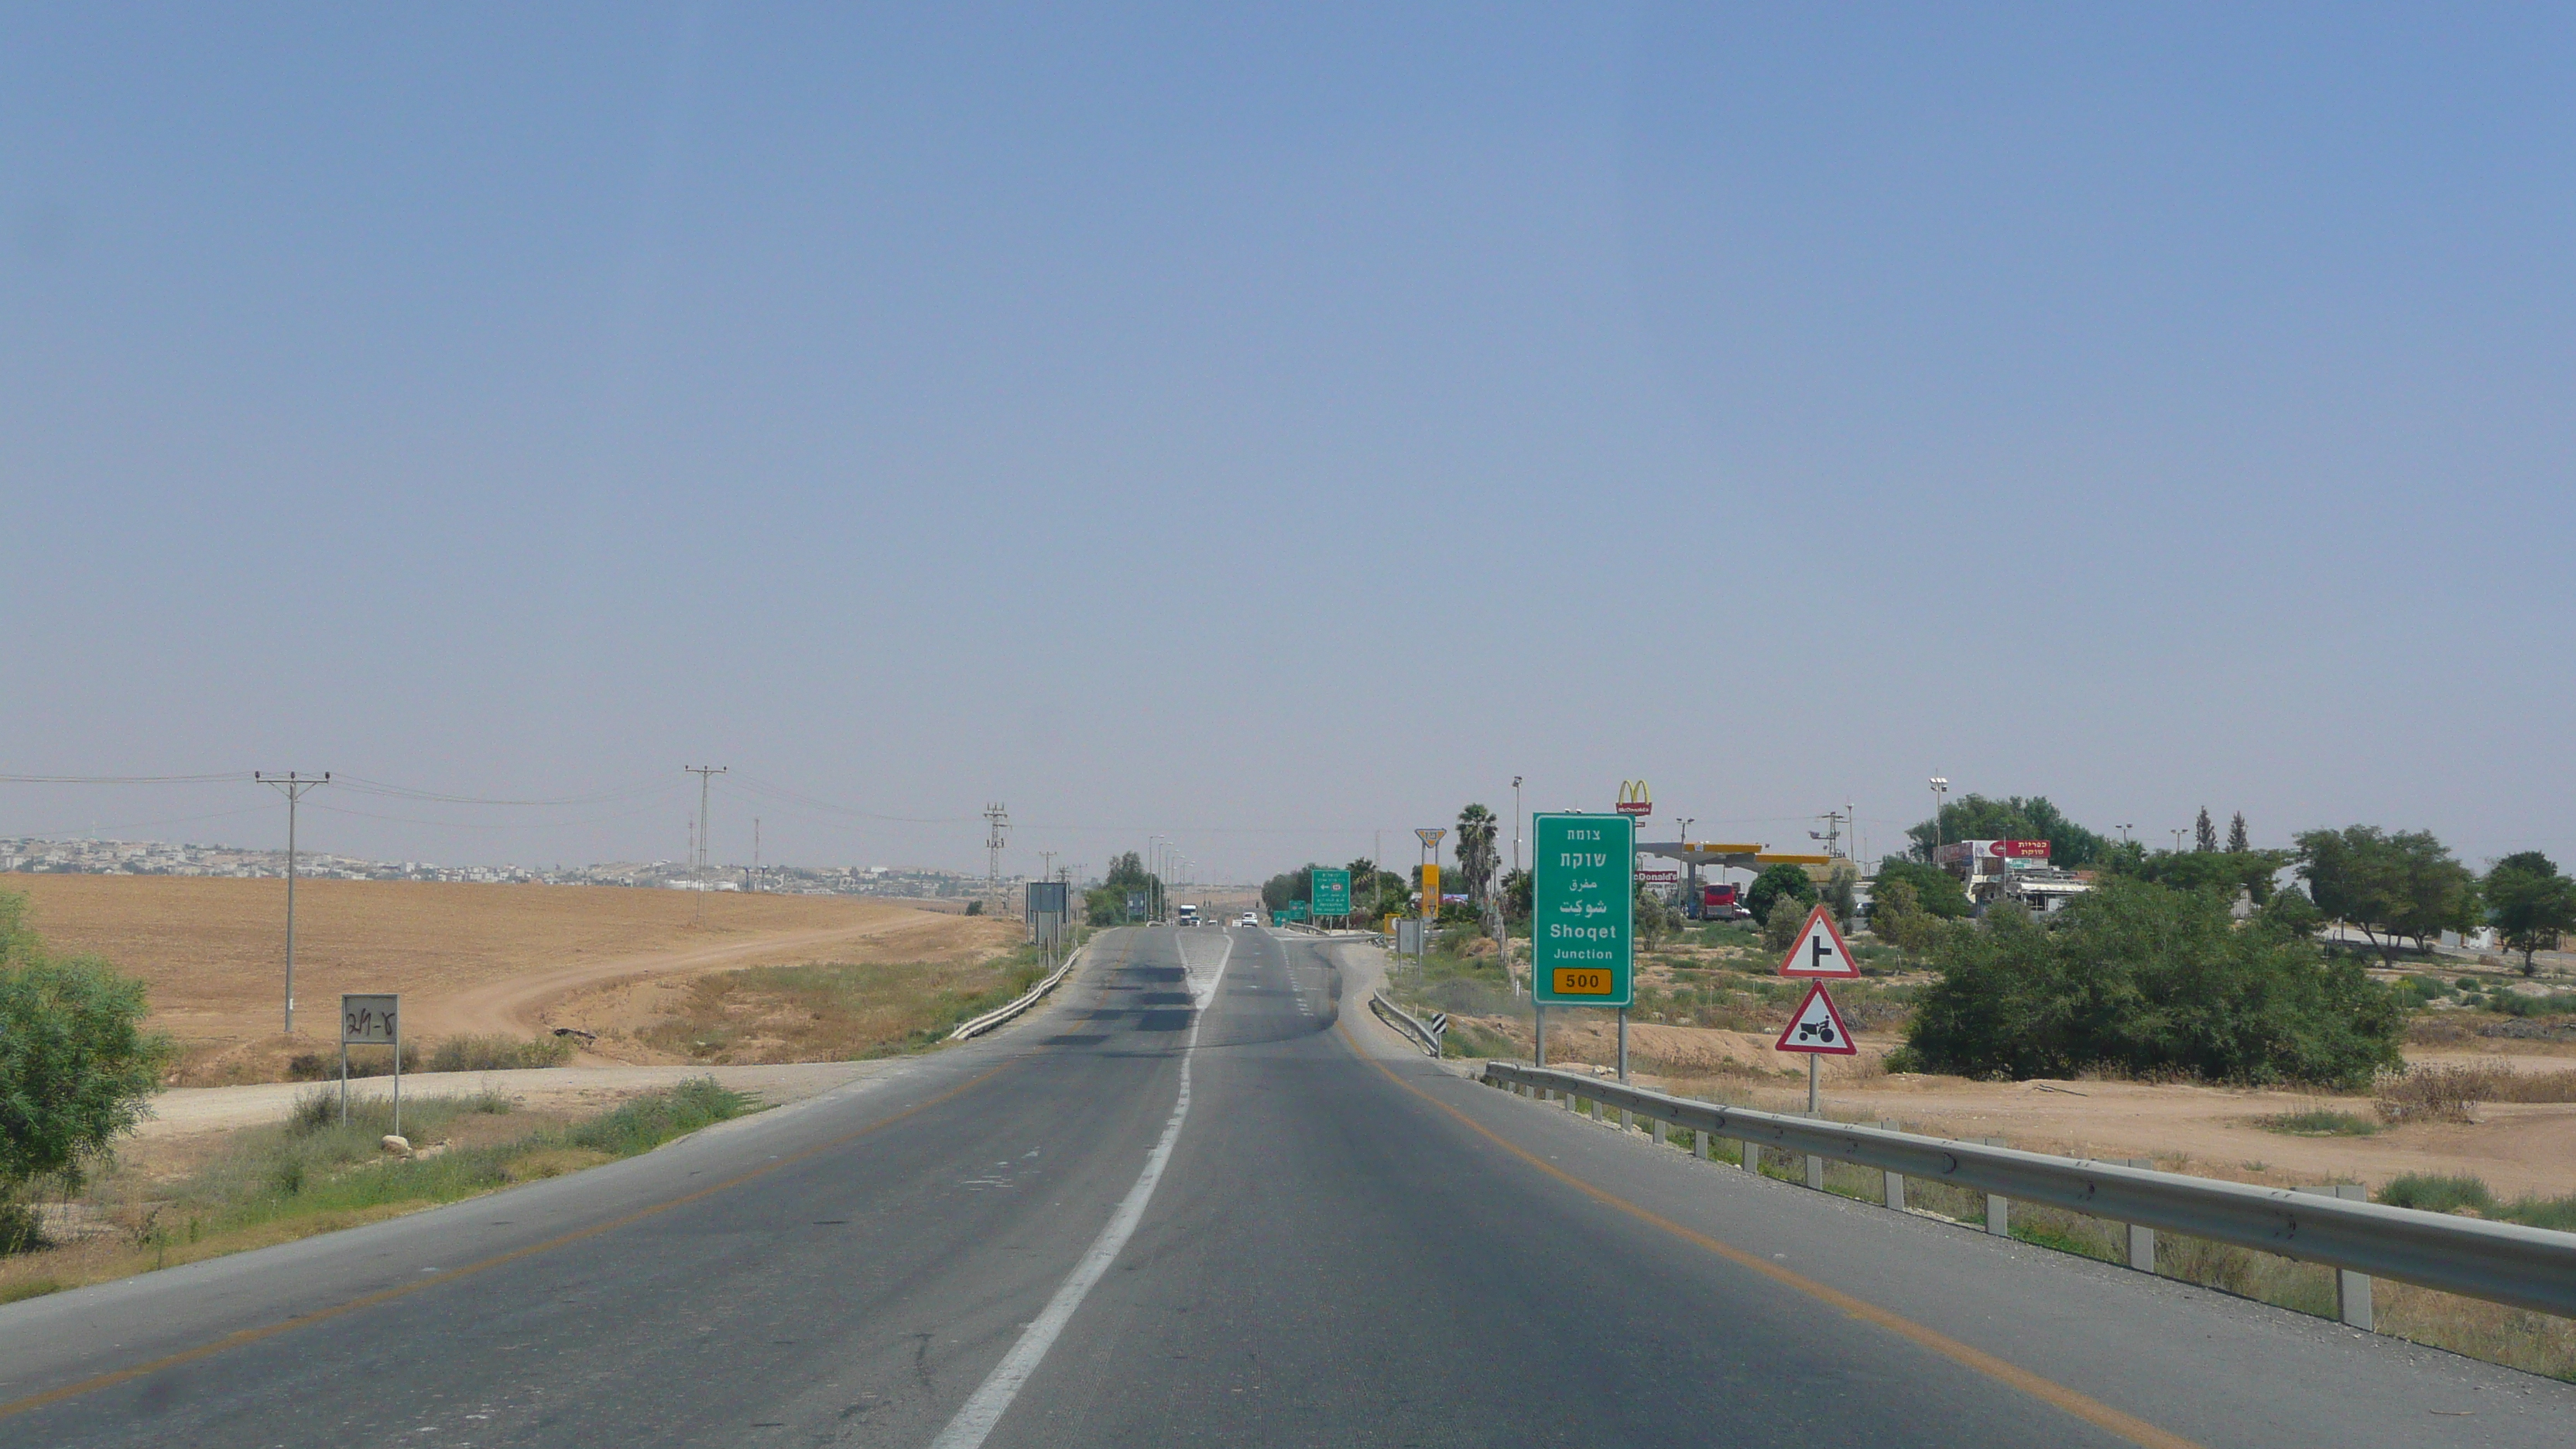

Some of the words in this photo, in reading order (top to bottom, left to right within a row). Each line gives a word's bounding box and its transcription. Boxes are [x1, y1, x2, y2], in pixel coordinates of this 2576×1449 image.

[1567, 829, 1601, 841] צומת
[1560, 853, 1606, 868] שוקת
[1633, 872, 1677, 881] cDonald's
[1569, 879, 1598, 892] مفرق
[1550, 923, 1616, 941] Shoqet
[1553, 949, 1612, 959] Junction
[1566, 975, 1599, 988] 500
